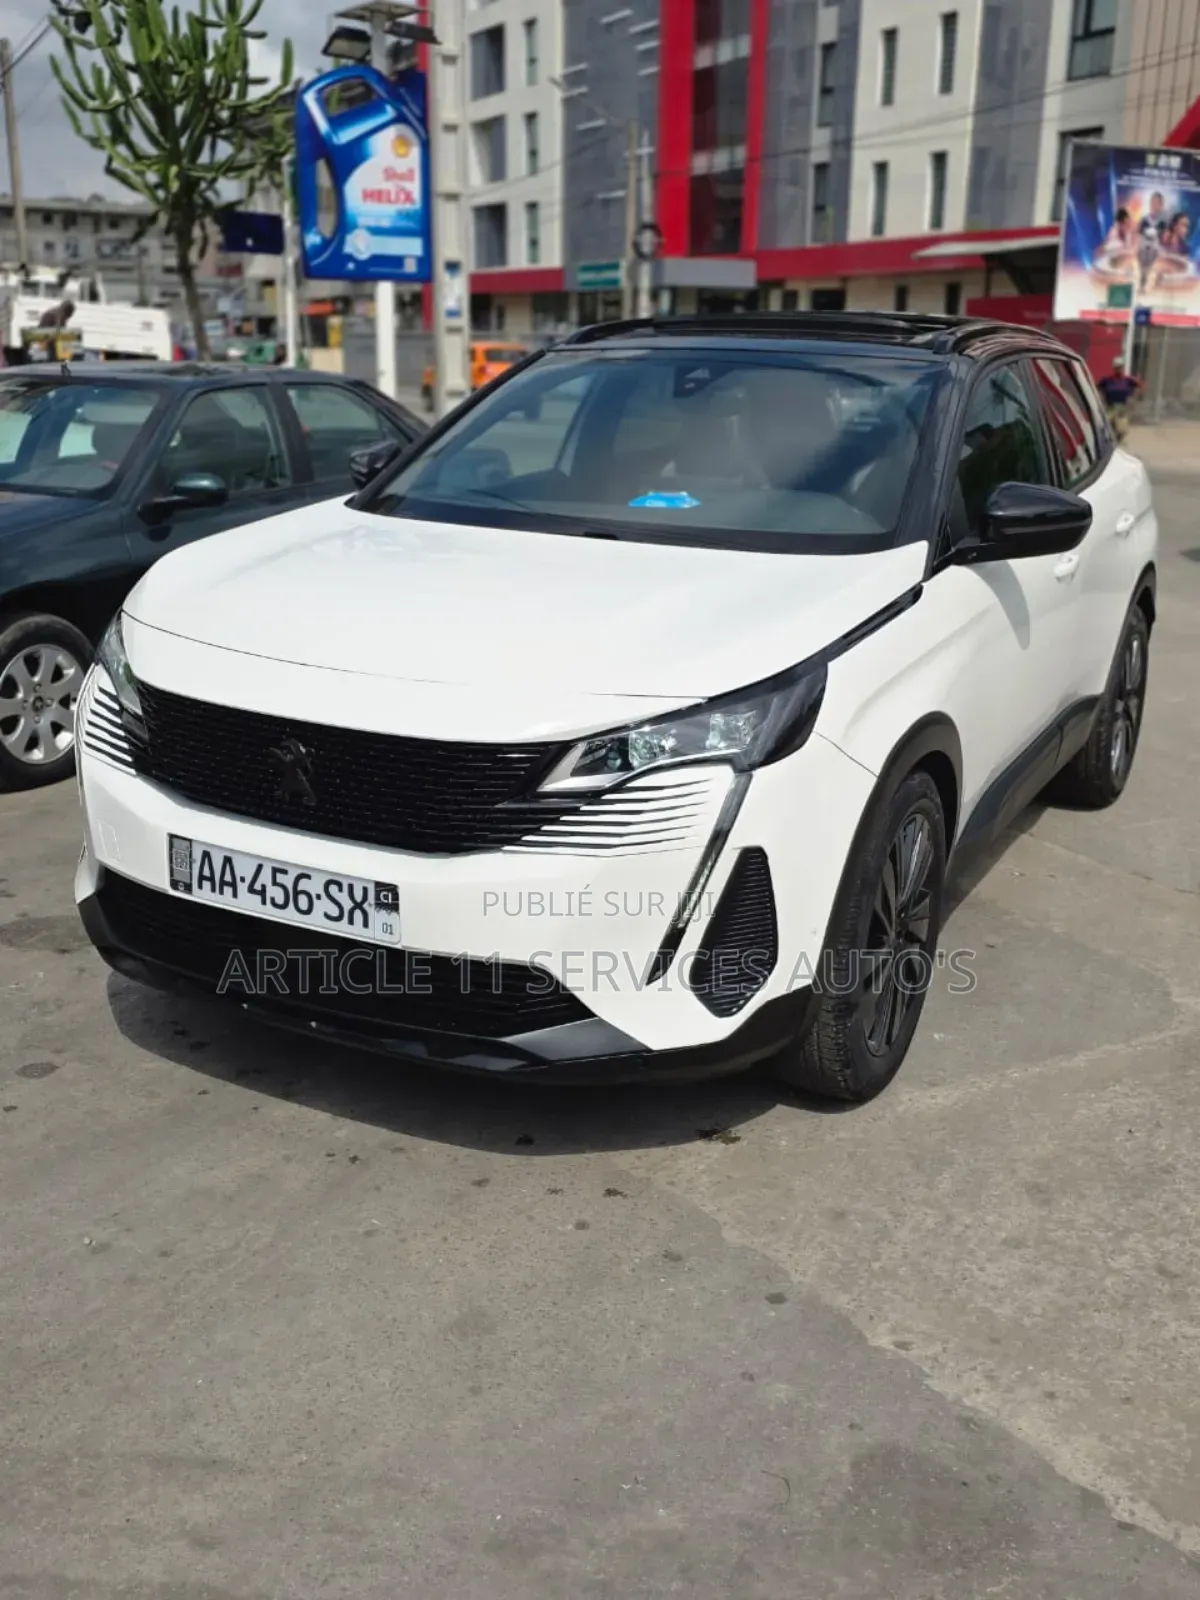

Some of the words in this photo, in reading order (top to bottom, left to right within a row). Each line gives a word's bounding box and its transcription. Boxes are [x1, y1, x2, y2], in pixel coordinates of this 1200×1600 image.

[362, 186, 416, 205] HELIX
[380, 891, 392, 904] CI
[382, 922, 393, 935] 01
